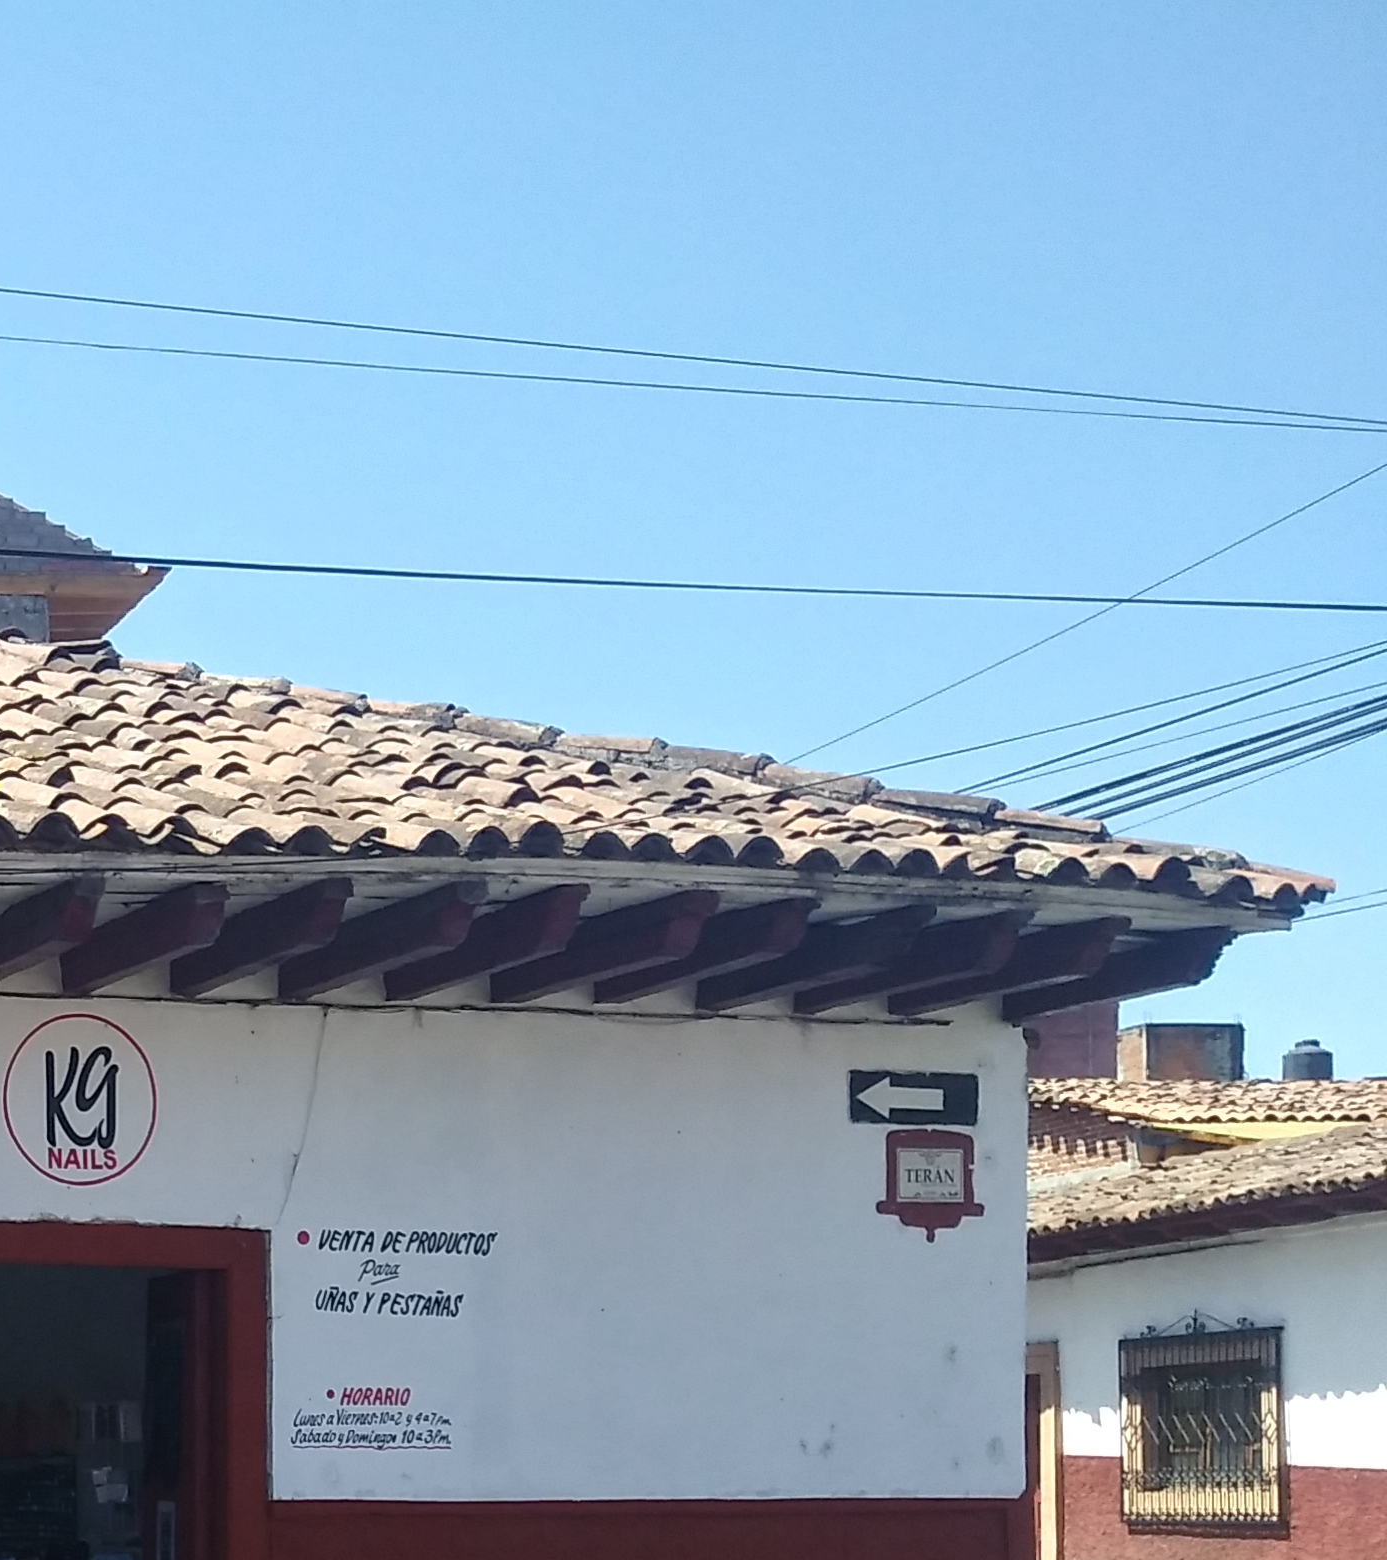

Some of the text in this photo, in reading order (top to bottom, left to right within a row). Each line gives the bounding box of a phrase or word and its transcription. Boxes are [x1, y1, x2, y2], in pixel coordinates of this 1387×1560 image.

[47, 1147, 117, 1170] NAILS
[318, 1229, 498, 1256] VENTA DE PRODUCTOS
[315, 1286, 464, 1318] UÑAS Y PESTAÑAS
[340, 1387, 411, 1406] HORARIO
[293, 1408, 326, 1427] Lunes
[327, 1413, 335, 1426] a
